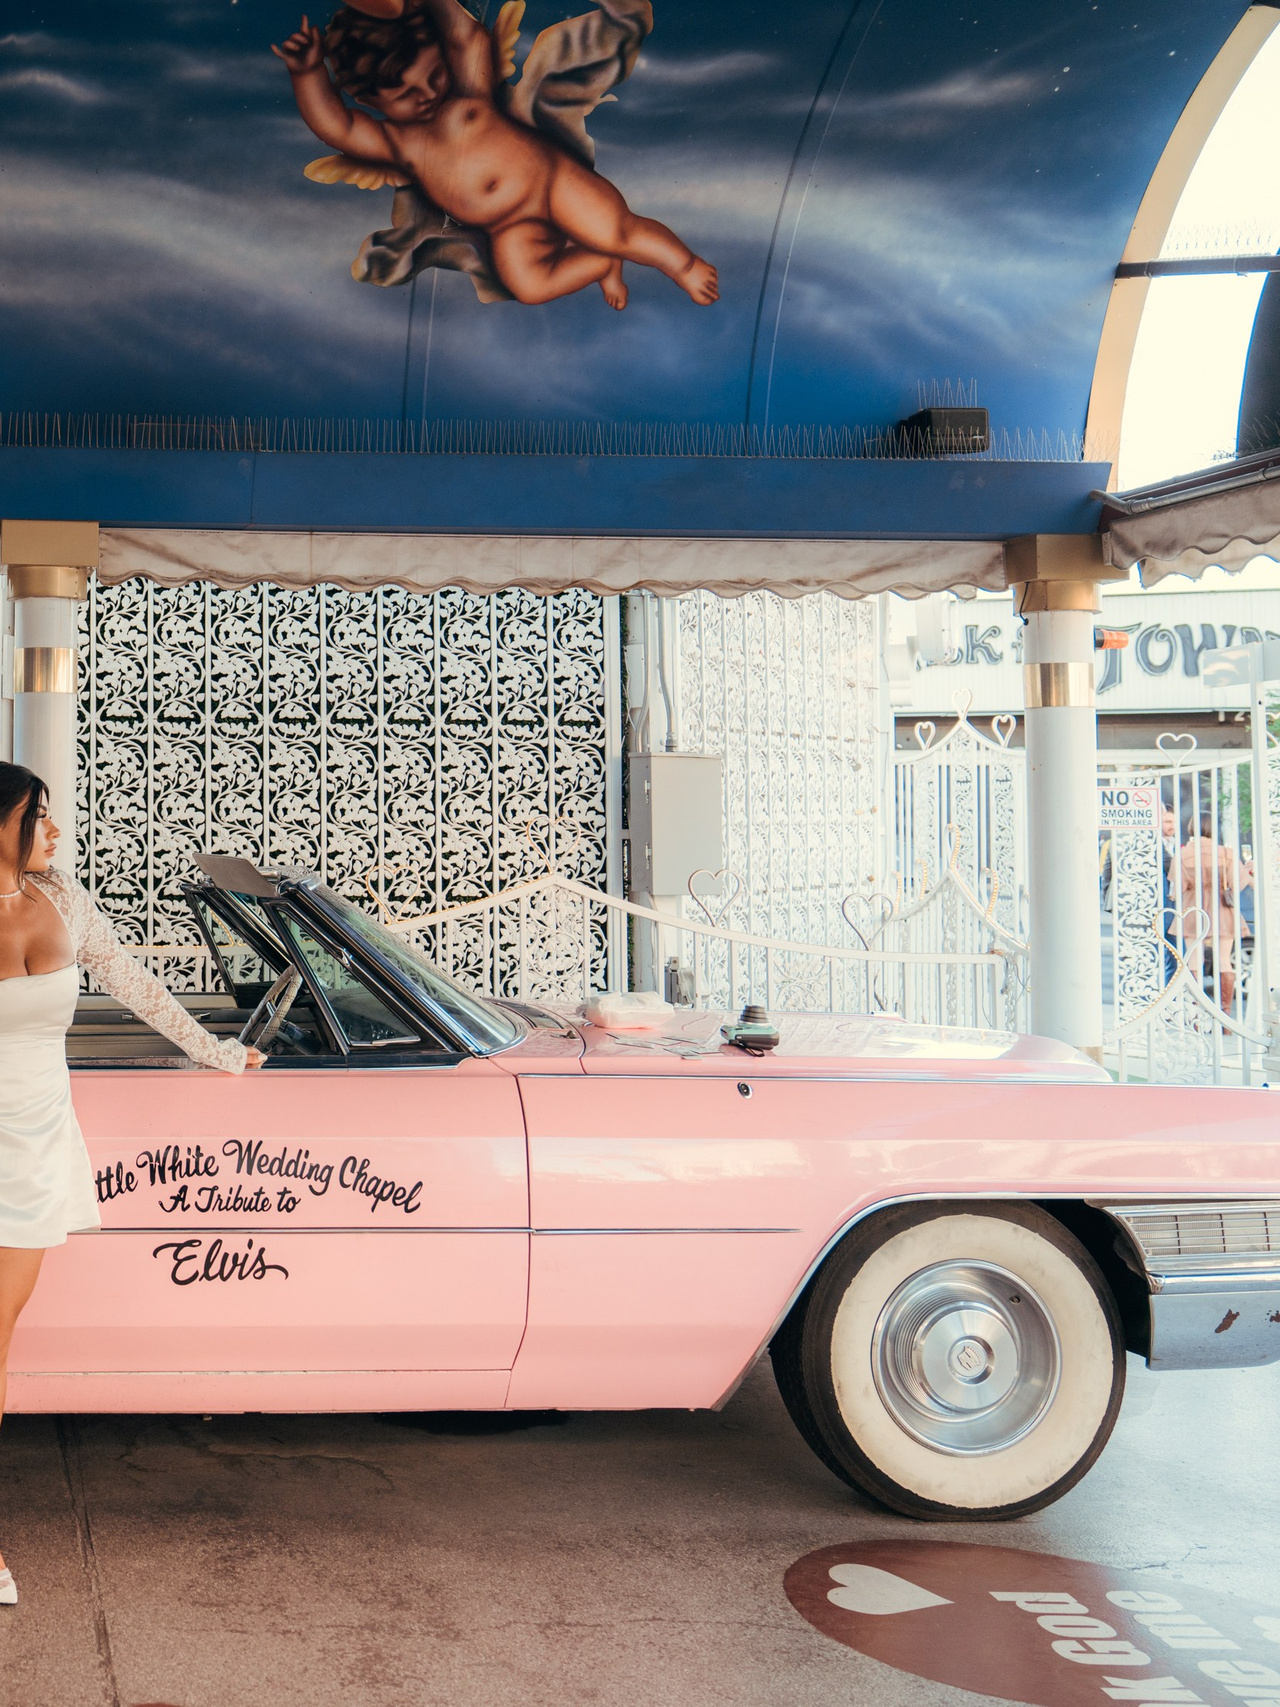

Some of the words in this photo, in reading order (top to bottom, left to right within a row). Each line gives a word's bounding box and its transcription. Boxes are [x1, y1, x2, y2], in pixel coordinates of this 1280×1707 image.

[1101, 790, 1129, 806] NO
[1101, 808, 1153, 818] SMOKING
[95, 1160, 138, 1203] ttle
[136, 1144, 219, 1187] White
[222, 1139, 335, 1196] Wedding
[339, 1155, 423, 1214] Chapel
[158, 1184, 190, 1213] A
[194, 1184, 272, 1213] Tribute
[272, 1186, 302, 1213] to
[153, 1238, 289, 1286] Elvis
[988, 1591, 1152, 1666] God
[1106, 1590, 1243, 1650] me
